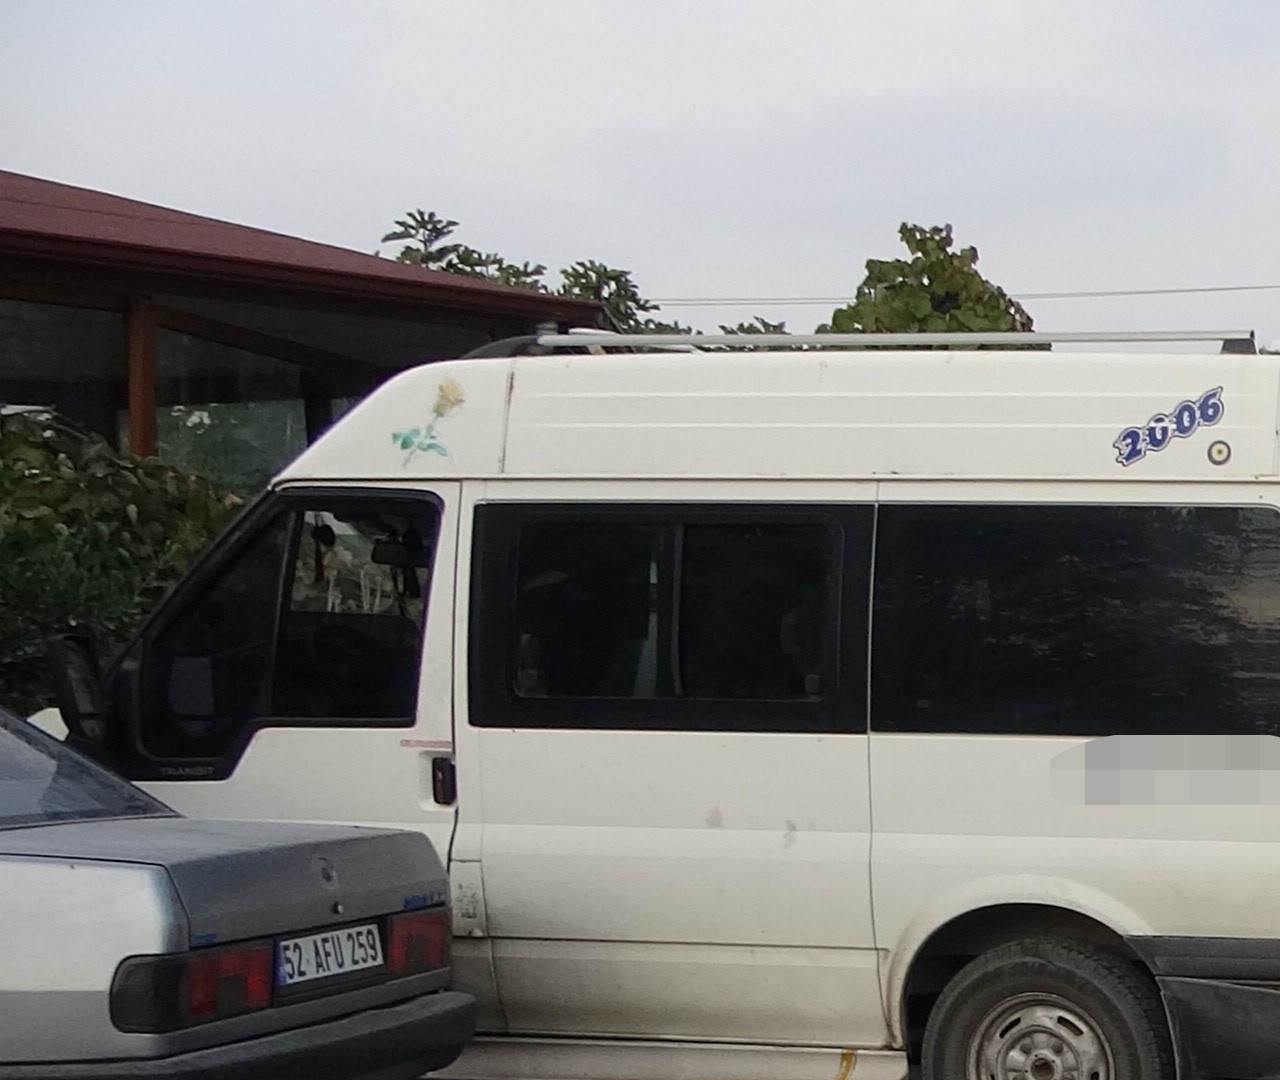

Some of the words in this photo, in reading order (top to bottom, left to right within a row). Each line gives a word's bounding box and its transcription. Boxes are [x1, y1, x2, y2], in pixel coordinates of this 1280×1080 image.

[1113, 386, 1224, 467] 2006
[283, 945, 306, 978] 52
[314, 936, 343, 974] AFU
[346, 928, 378, 967] 259
